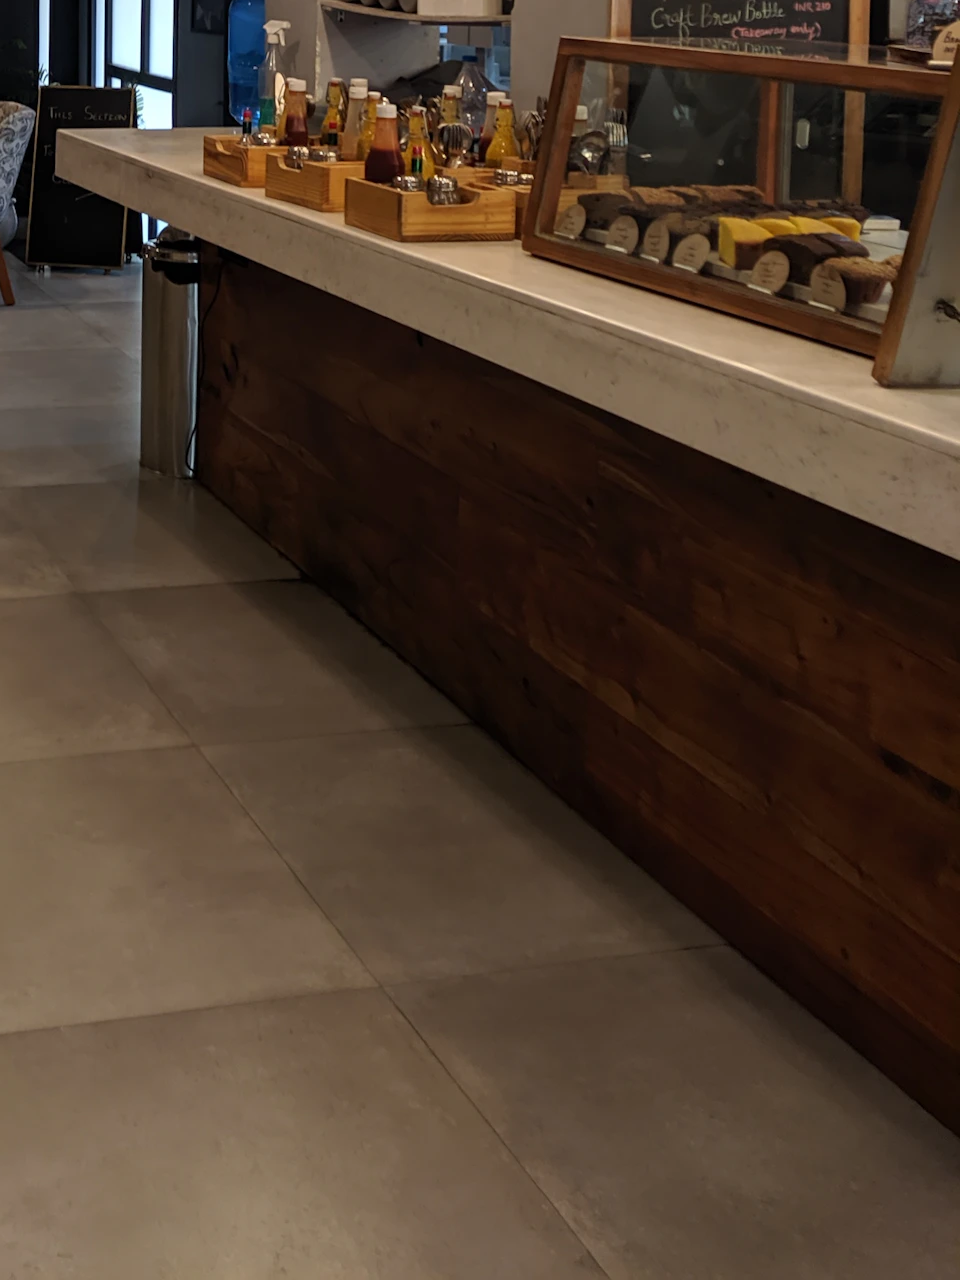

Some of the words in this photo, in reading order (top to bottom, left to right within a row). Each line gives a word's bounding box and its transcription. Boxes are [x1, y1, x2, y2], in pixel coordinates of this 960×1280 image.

[700, 2, 741, 28] Brew
[795, 1, 814, 13] INR
[790, 22, 822, 41] only)
